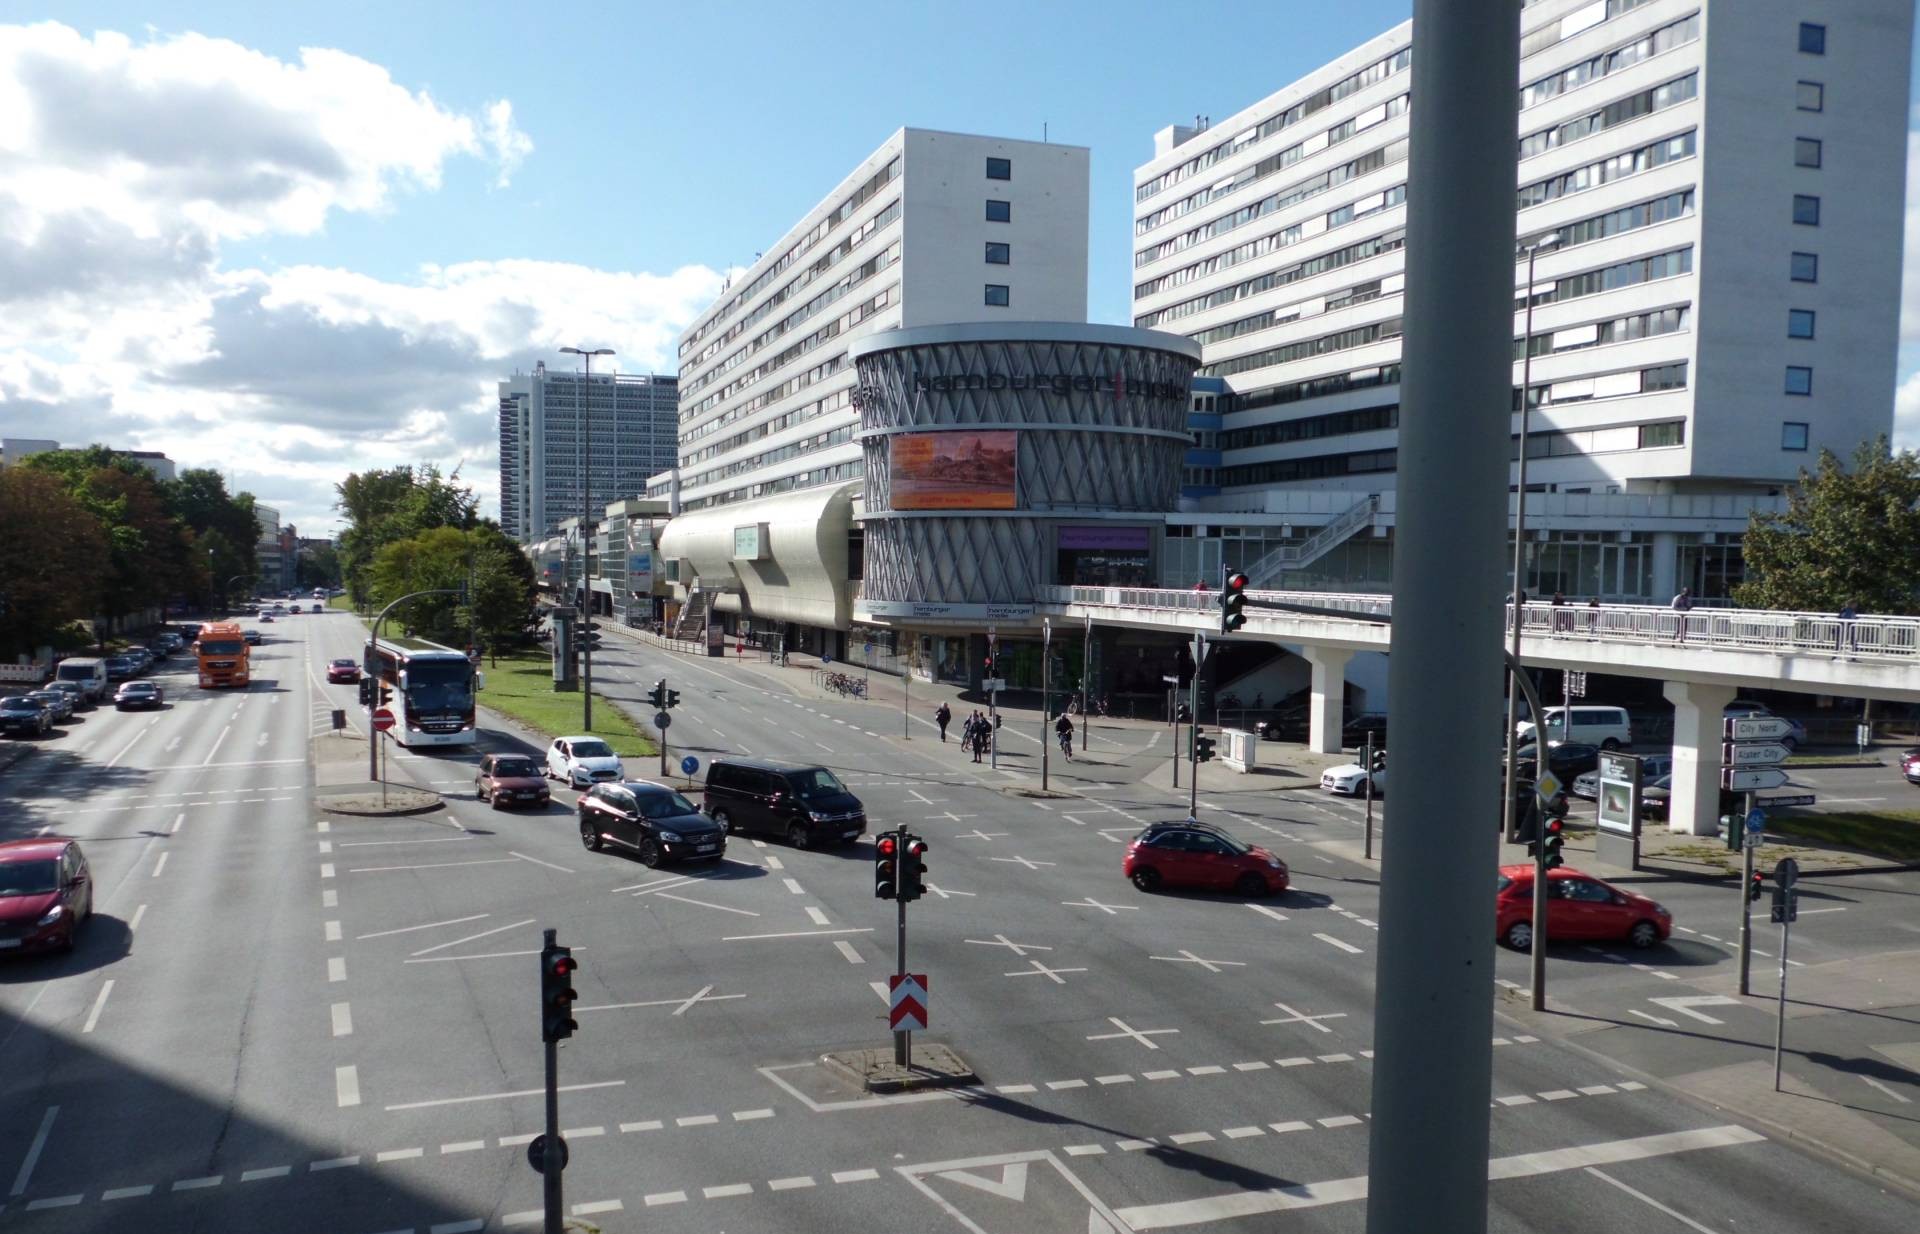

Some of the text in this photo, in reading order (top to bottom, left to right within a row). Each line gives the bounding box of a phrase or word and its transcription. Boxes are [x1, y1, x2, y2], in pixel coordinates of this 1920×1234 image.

[914, 371, 1115, 397] hamburger
[988, 606, 1032, 615] hamburger
[1739, 723, 1778, 734] City Nord
[1763, 748, 1779, 759] City
